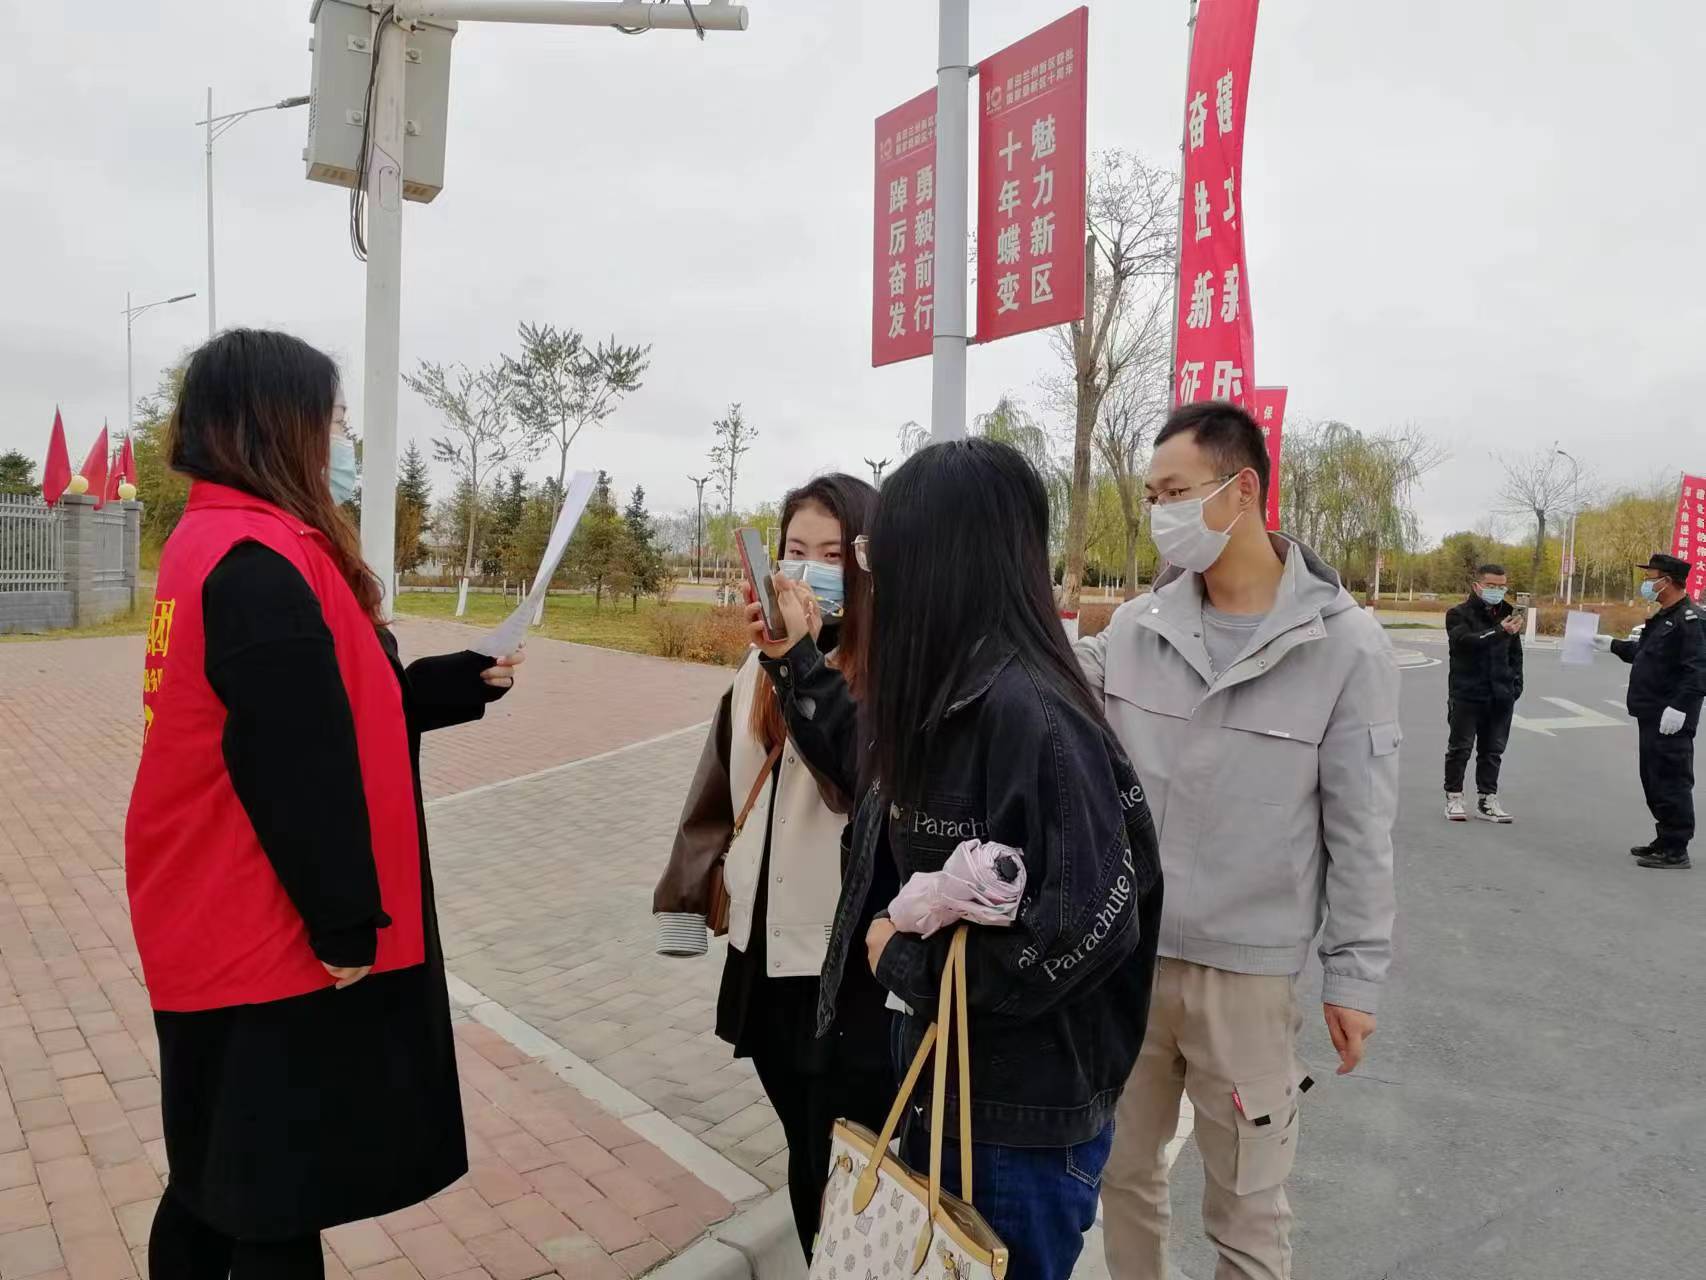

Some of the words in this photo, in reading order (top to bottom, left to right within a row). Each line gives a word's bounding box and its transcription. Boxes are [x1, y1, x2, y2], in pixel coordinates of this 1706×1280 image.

[888, 176, 908, 340] 踔厉奋发
[913, 164, 935, 333] 勇毅前行
[997, 131, 1023, 316] 十年蝶变
[1030, 113, 1057, 306] 魅力新区
[1040, 874, 1131, 983] Parachute
